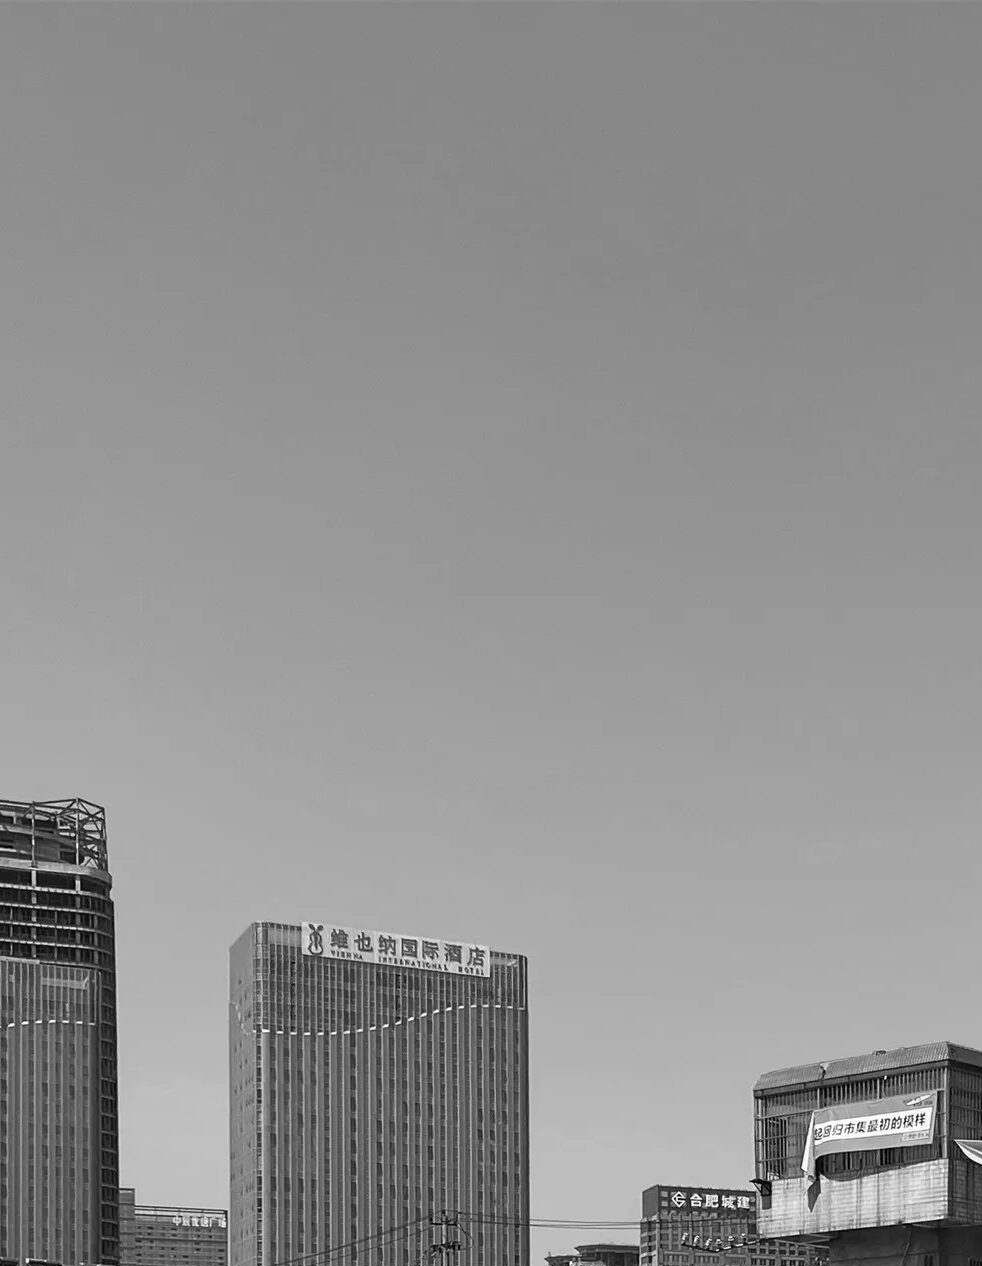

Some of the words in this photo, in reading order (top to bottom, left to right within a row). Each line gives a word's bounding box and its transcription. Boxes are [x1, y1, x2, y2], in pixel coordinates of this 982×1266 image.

[330, 928, 486, 968] 维也纳国际酒店
[331, 950, 364, 961] VIENNA
[378, 956, 449, 971] INTERNATIONAL
[689, 1193, 750, 1210] 合肥城建
